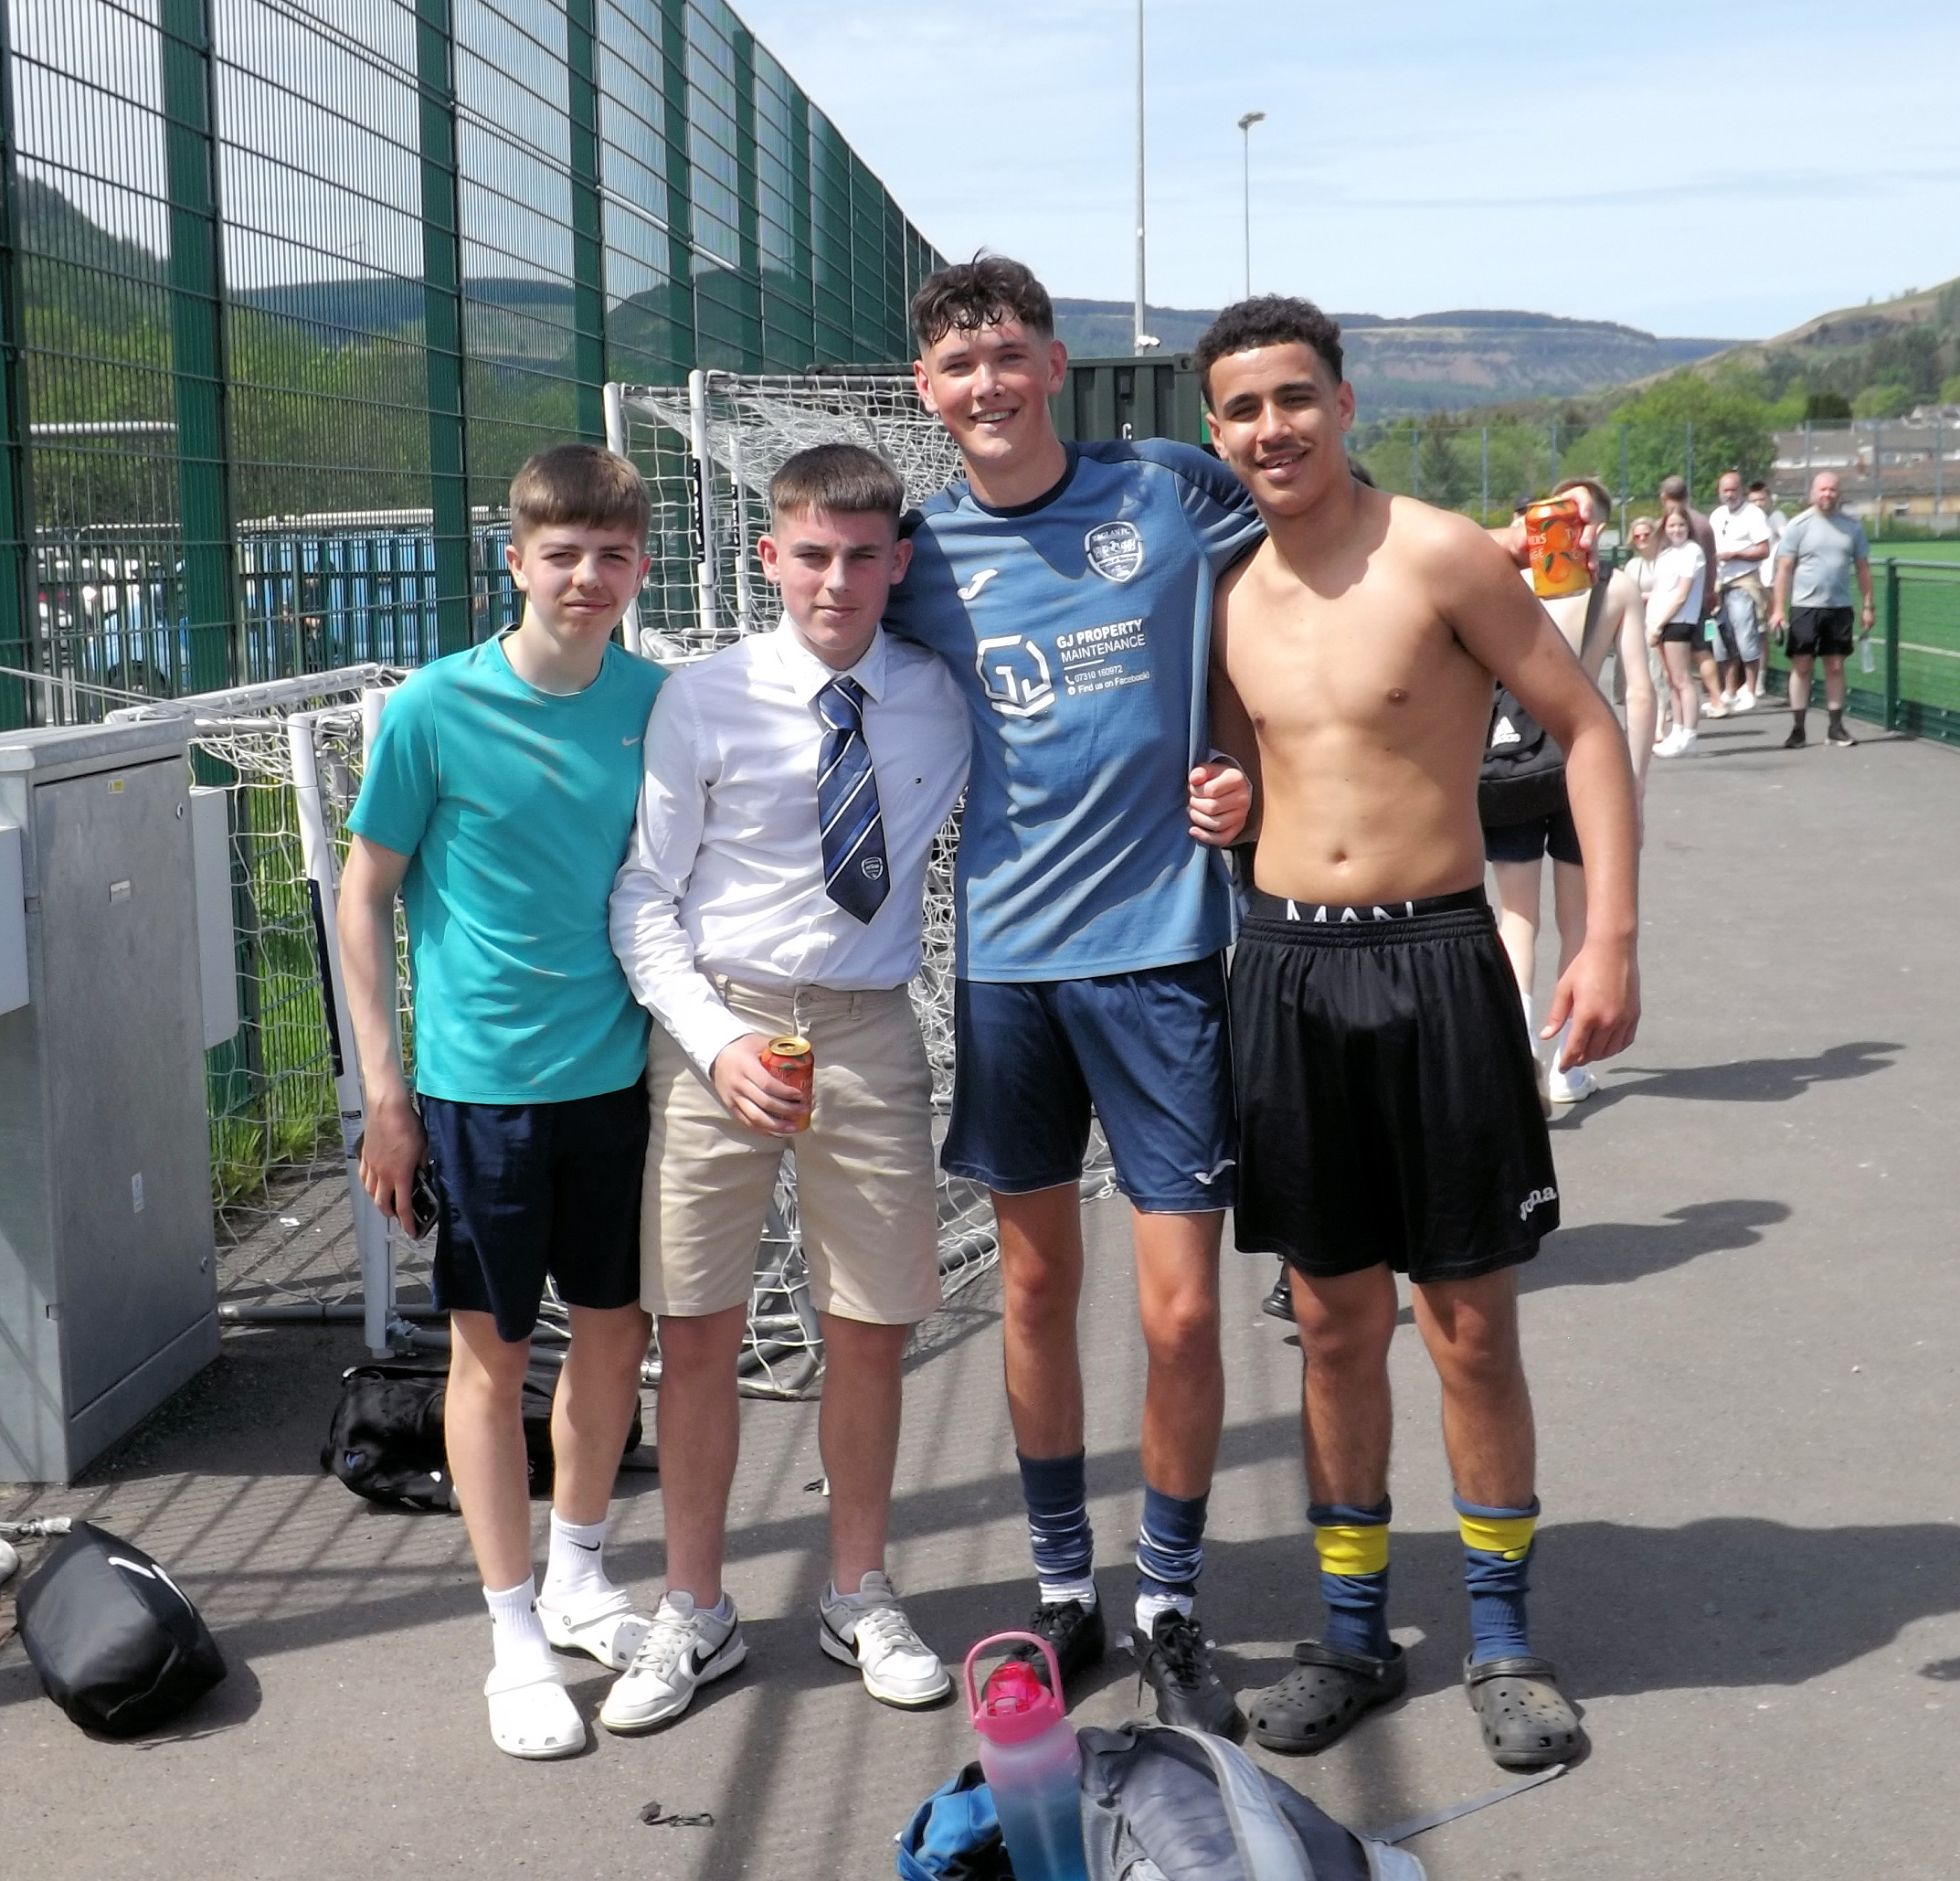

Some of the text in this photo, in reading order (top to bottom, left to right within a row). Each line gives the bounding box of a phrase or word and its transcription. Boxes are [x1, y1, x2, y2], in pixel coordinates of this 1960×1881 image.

[1057, 619, 1142, 648] GJ PROPERTY
[1061, 634, 1146, 663] MAINTENANCE
[1075, 671, 1096, 683] 07310
[1078, 684, 1094, 694] Find
